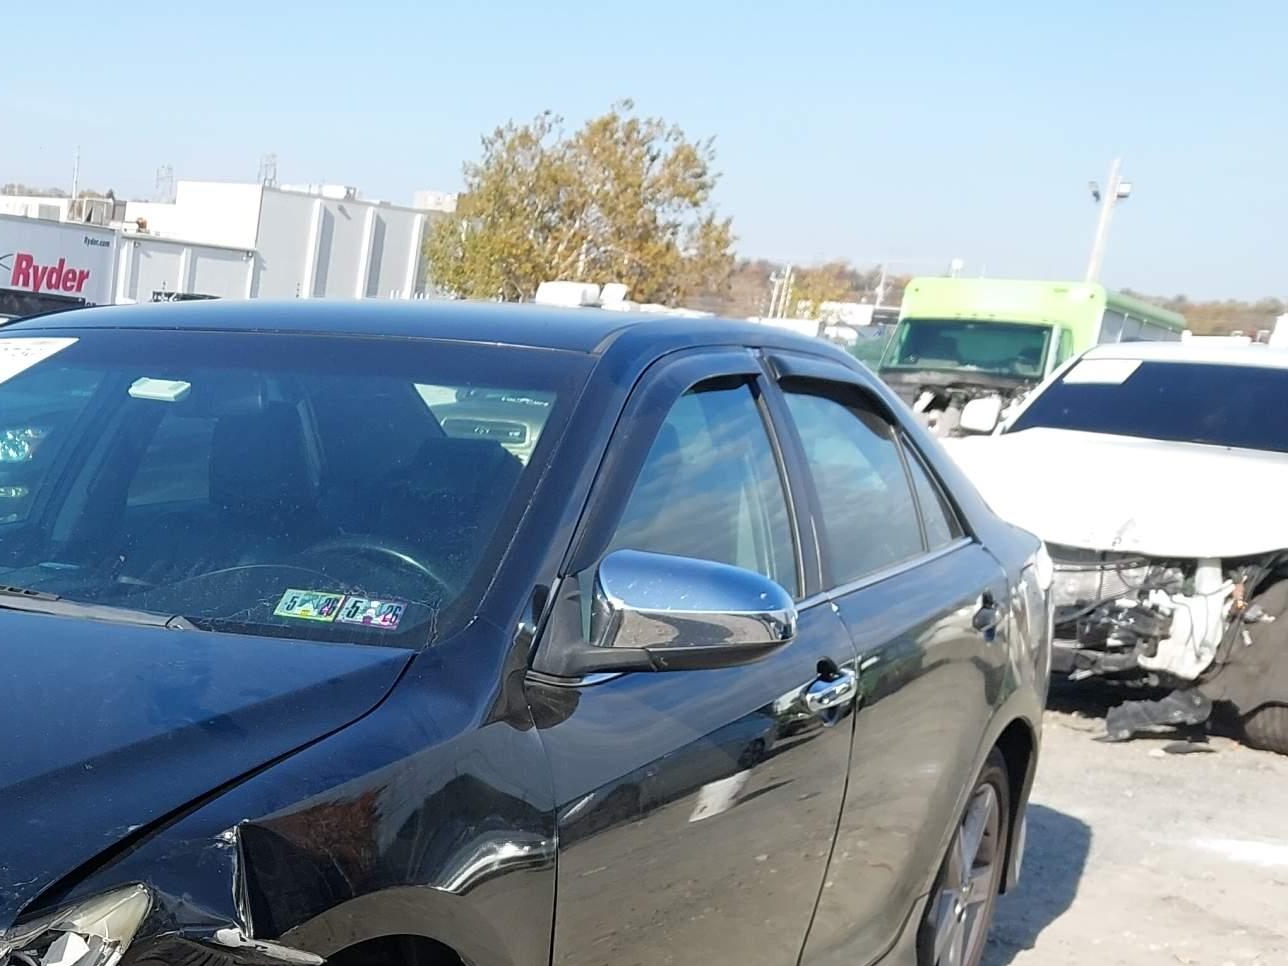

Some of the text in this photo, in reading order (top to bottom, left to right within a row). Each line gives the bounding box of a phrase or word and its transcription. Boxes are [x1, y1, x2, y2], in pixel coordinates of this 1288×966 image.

[84, 236, 110, 247] Ryder.com
[11, 252, 90, 293] Ryder
[346, 600, 402, 624] 5 26
